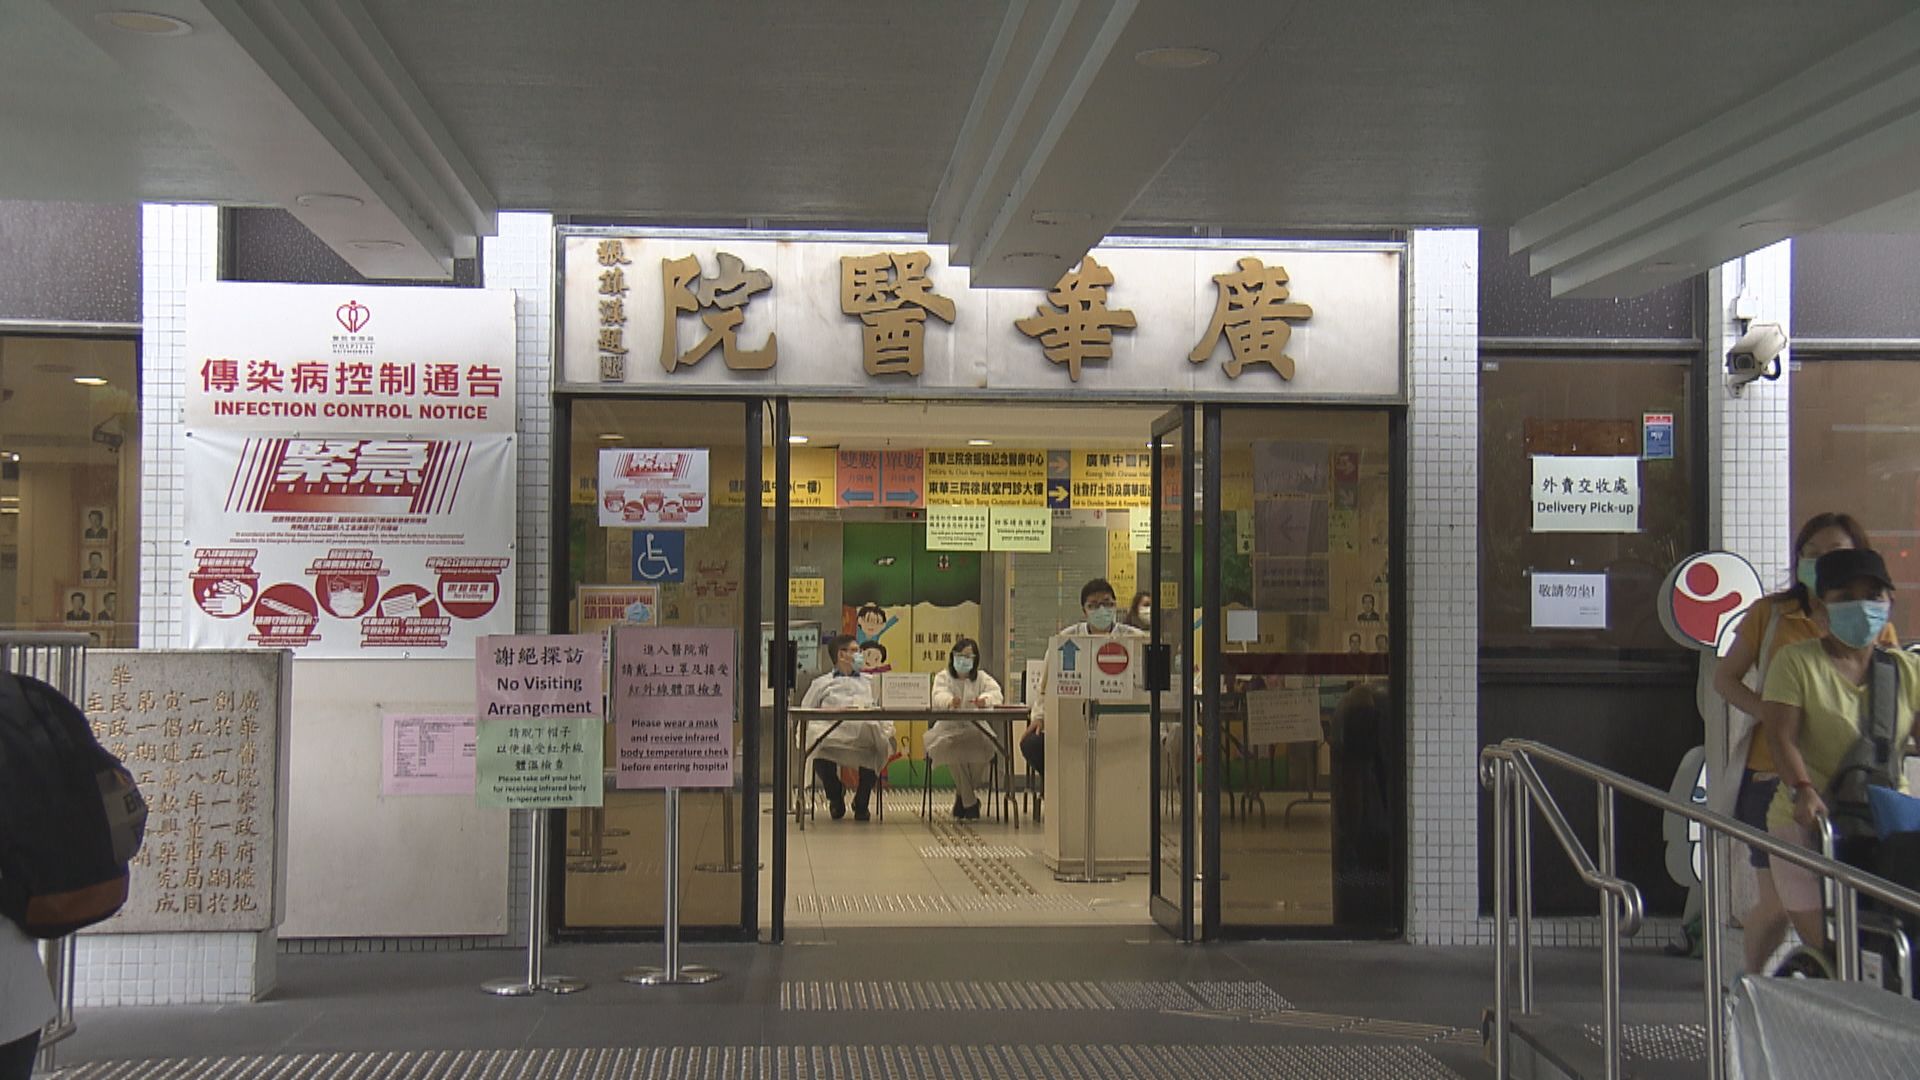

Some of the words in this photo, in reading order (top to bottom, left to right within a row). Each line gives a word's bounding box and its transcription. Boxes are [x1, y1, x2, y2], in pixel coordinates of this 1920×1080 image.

[200, 359, 503, 398] 傳染病控制通告
[214, 401, 318, 417] INFECTION
[323, 403, 413, 419] CONTROL
[419, 404, 488, 420] NOTICE
[276, 440, 430, 484] 緊急
[1537, 501, 1586, 515] Delivery
[1590, 502, 1634, 515] Pick-up
[494, 646, 584, 666] 謝絕探訪
[643, 644, 709, 657] 進入醫院前
[621, 663, 729, 677] 請戴上口罩及接受
[497, 678, 519, 691] No
[524, 677, 583, 692] Visiting
[628, 683, 722, 697] 紅外線體溫檢查
[487, 700, 592, 717] Arrangement
[631, 718, 661, 729] Please
[663, 720, 687, 729] wear
[688, 721, 695, 729] a
[696, 719, 719, 729] mask
[630, 732, 647, 743] and
[650, 732, 683, 743] receive
[685, 732, 720, 743] infrared
[620, 747, 644, 759] body
[646, 748, 702, 759] temperature
[703, 747, 729, 758] check
[621, 761, 651, 773] before
[653, 762, 691, 774] entering
[692, 761, 729, 774] hospital
